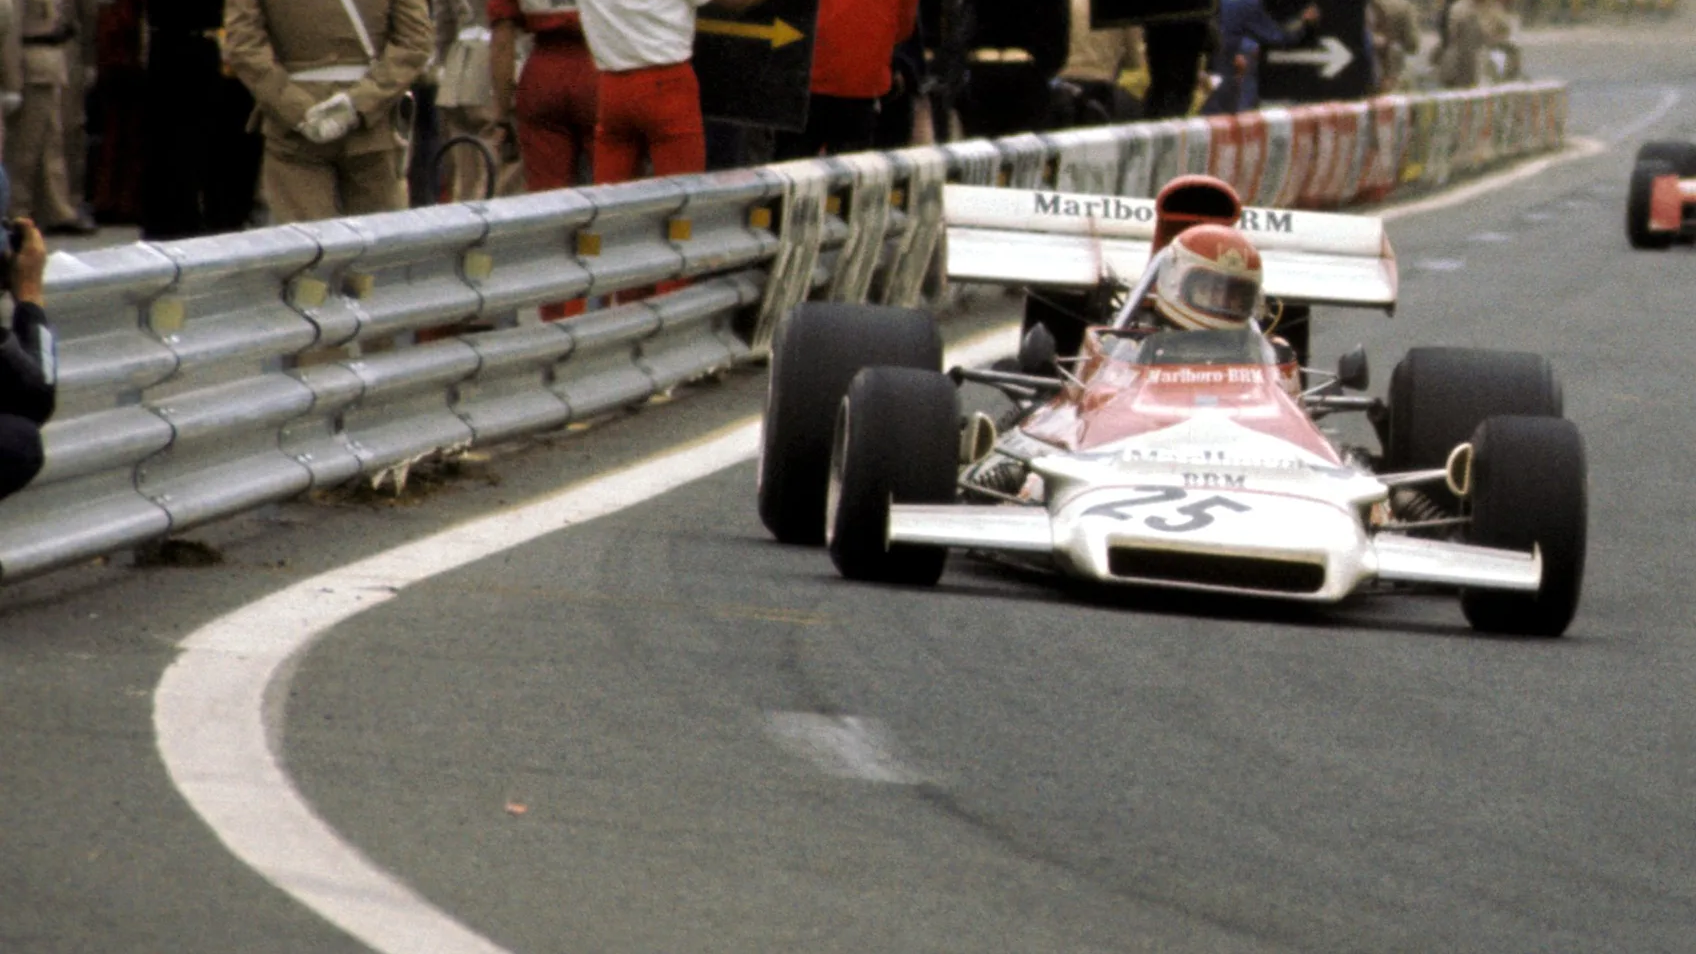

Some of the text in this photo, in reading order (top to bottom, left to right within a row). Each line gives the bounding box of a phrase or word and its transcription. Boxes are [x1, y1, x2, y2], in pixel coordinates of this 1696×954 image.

[1034, 192, 1294, 233] Marlbo RM
[1080, 484, 1253, 533] 25
